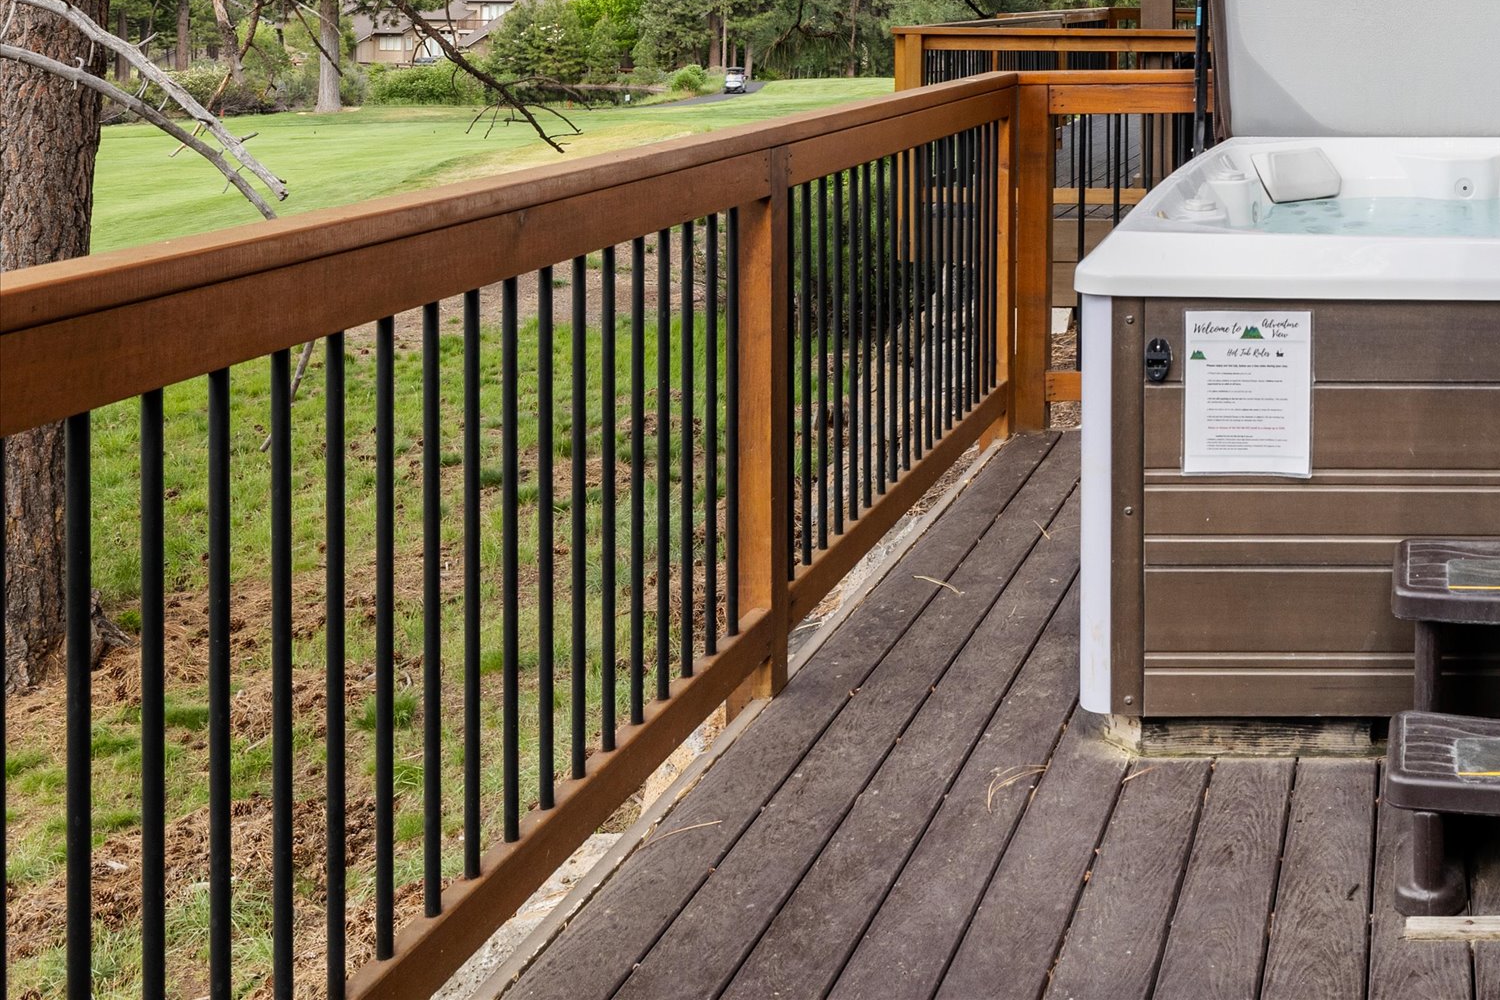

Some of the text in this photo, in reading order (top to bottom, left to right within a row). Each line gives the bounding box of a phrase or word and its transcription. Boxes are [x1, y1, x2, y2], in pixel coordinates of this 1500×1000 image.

[1193, 322, 1242, 335] Welcome to
[1261, 318, 1299, 329] Adventure
[1271, 329, 1289, 338] View
[1252, 347, 1270, 358] Rules
